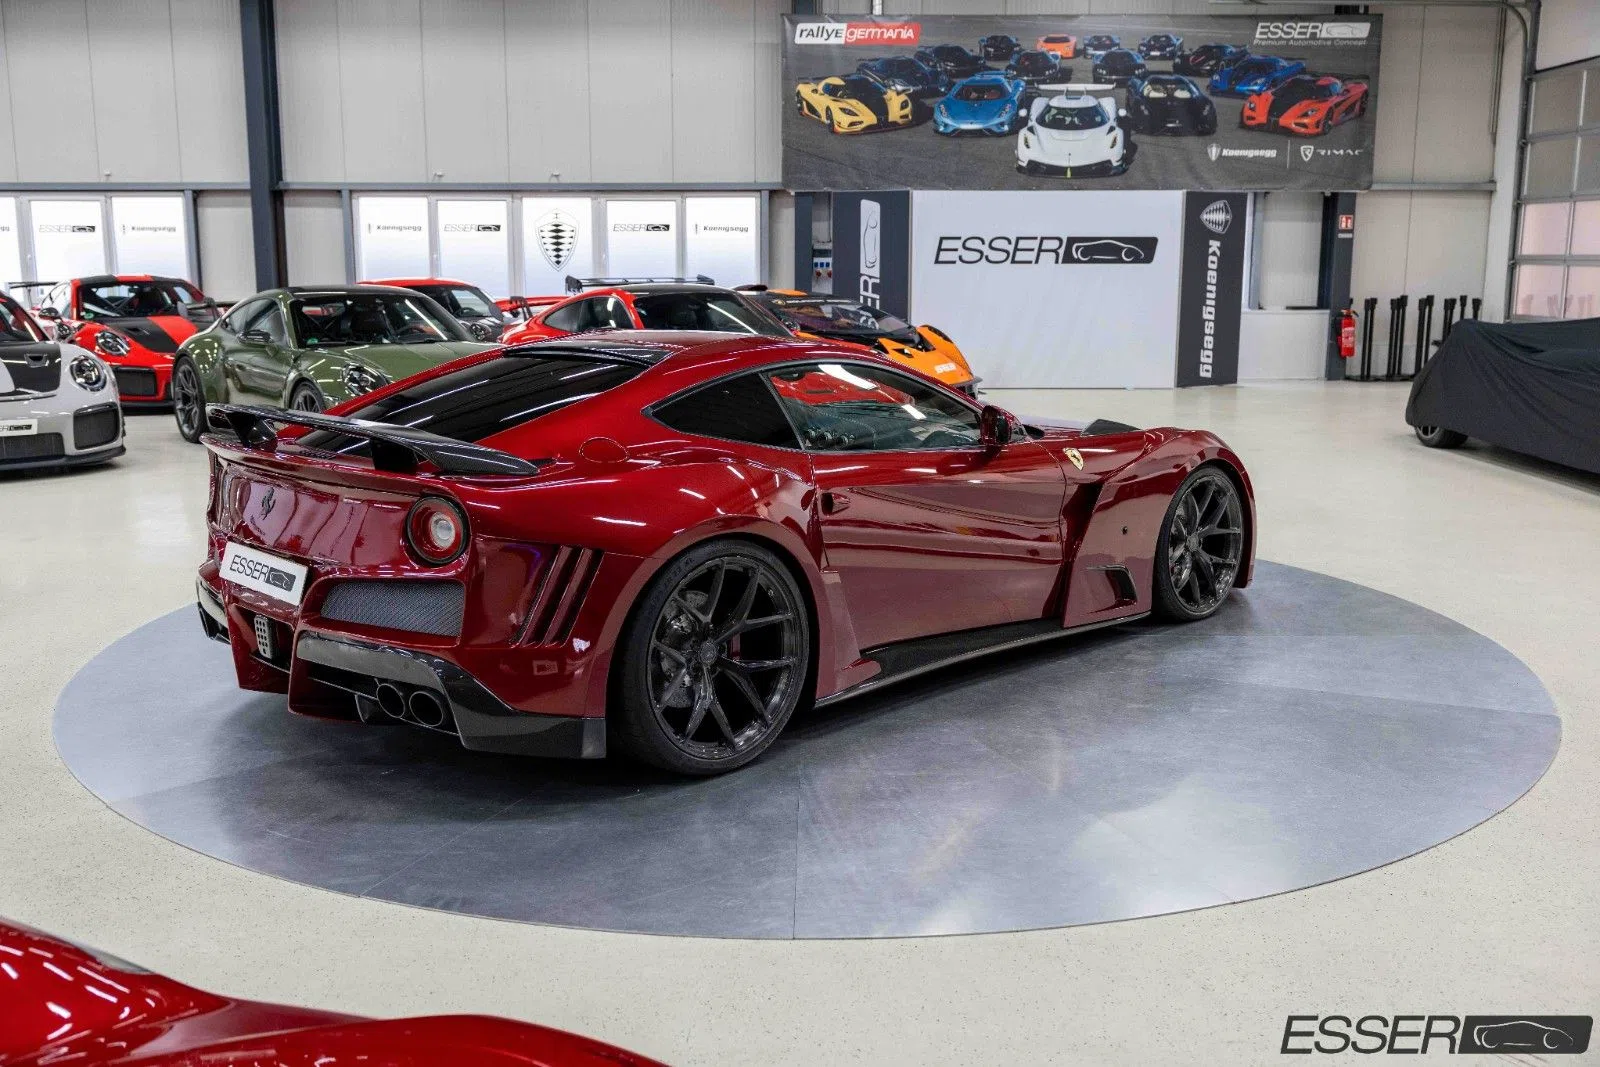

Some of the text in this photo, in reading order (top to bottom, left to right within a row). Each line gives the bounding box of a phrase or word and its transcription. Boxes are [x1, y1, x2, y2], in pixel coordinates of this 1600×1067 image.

[1255, 22, 1322, 39] ESSER
[38, 224, 72, 233] ESSER
[444, 224, 478, 232] ESSER
[613, 223, 647, 232] ESSER
[934, 236, 1064, 265] ESSER
[1199, 239, 1221, 379] Koenigsegg
[229, 554, 270, 583] ESSER
